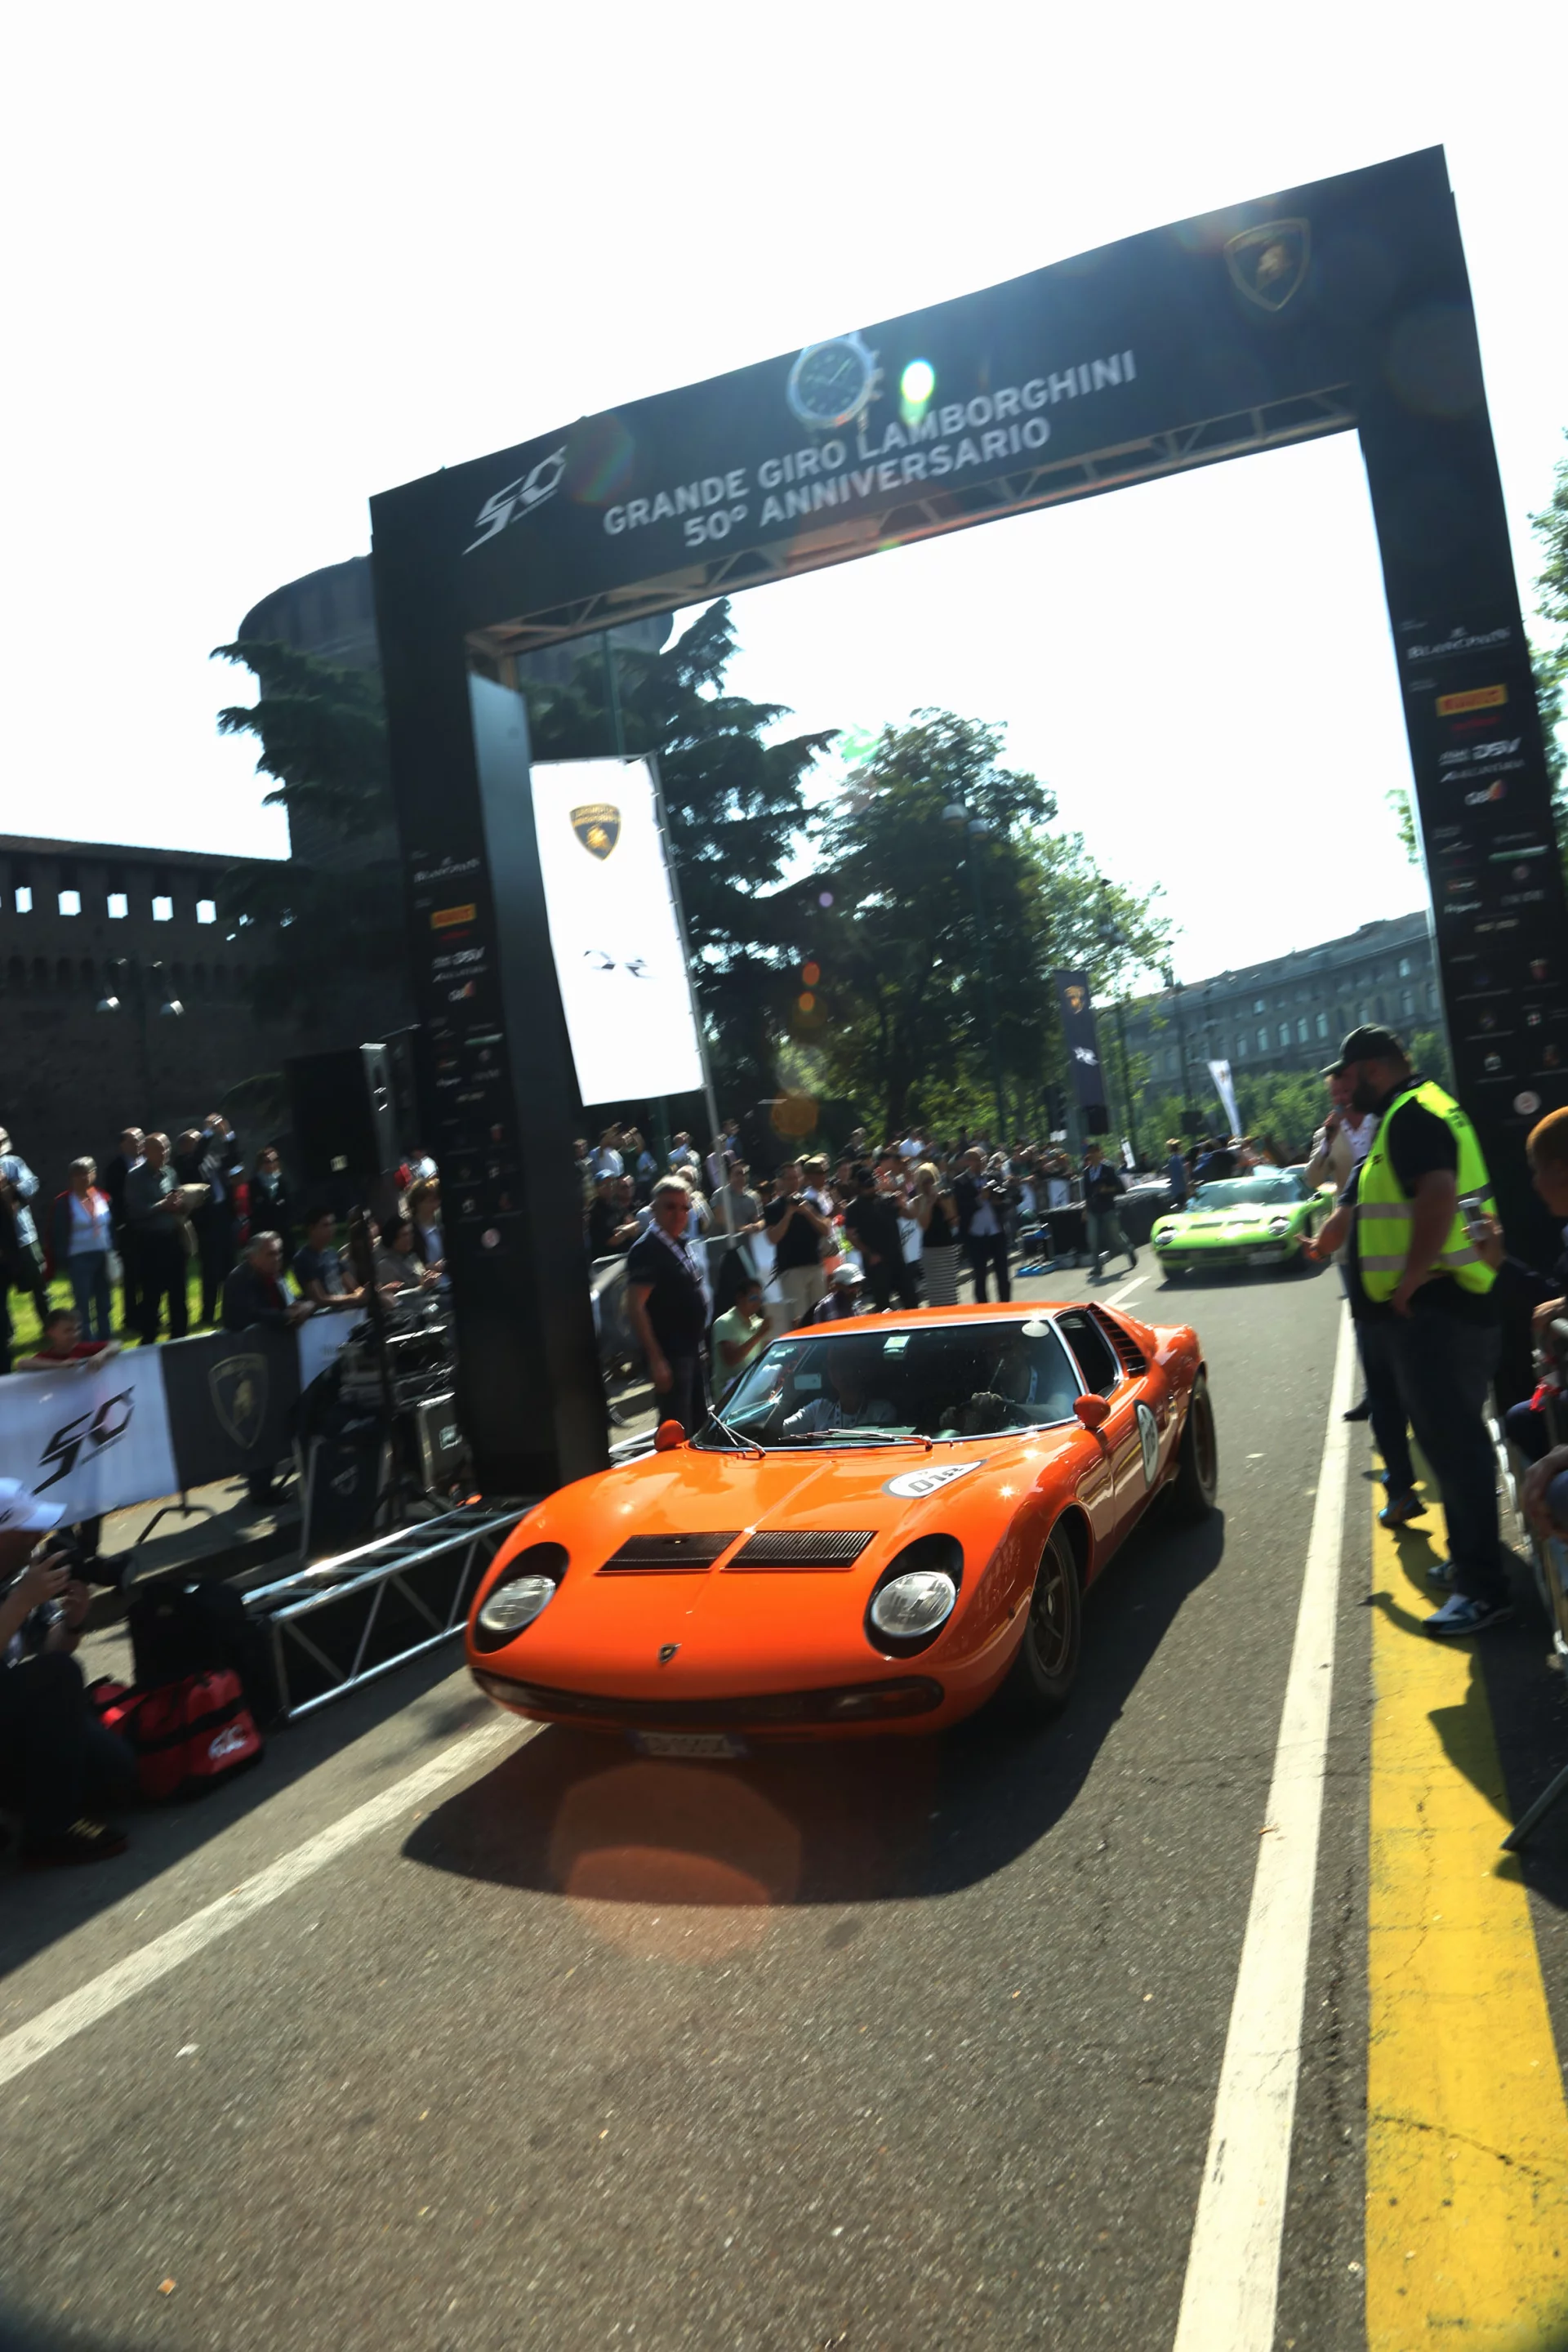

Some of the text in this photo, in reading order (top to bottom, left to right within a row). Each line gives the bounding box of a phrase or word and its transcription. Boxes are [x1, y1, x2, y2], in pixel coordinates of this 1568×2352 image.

[603, 467, 751, 536] GRANDE
[757, 439, 847, 489] GIRO
[858, 350, 1138, 461] LAMBORGHINI
[760, 416, 1051, 528] ANNIVERSARIO
